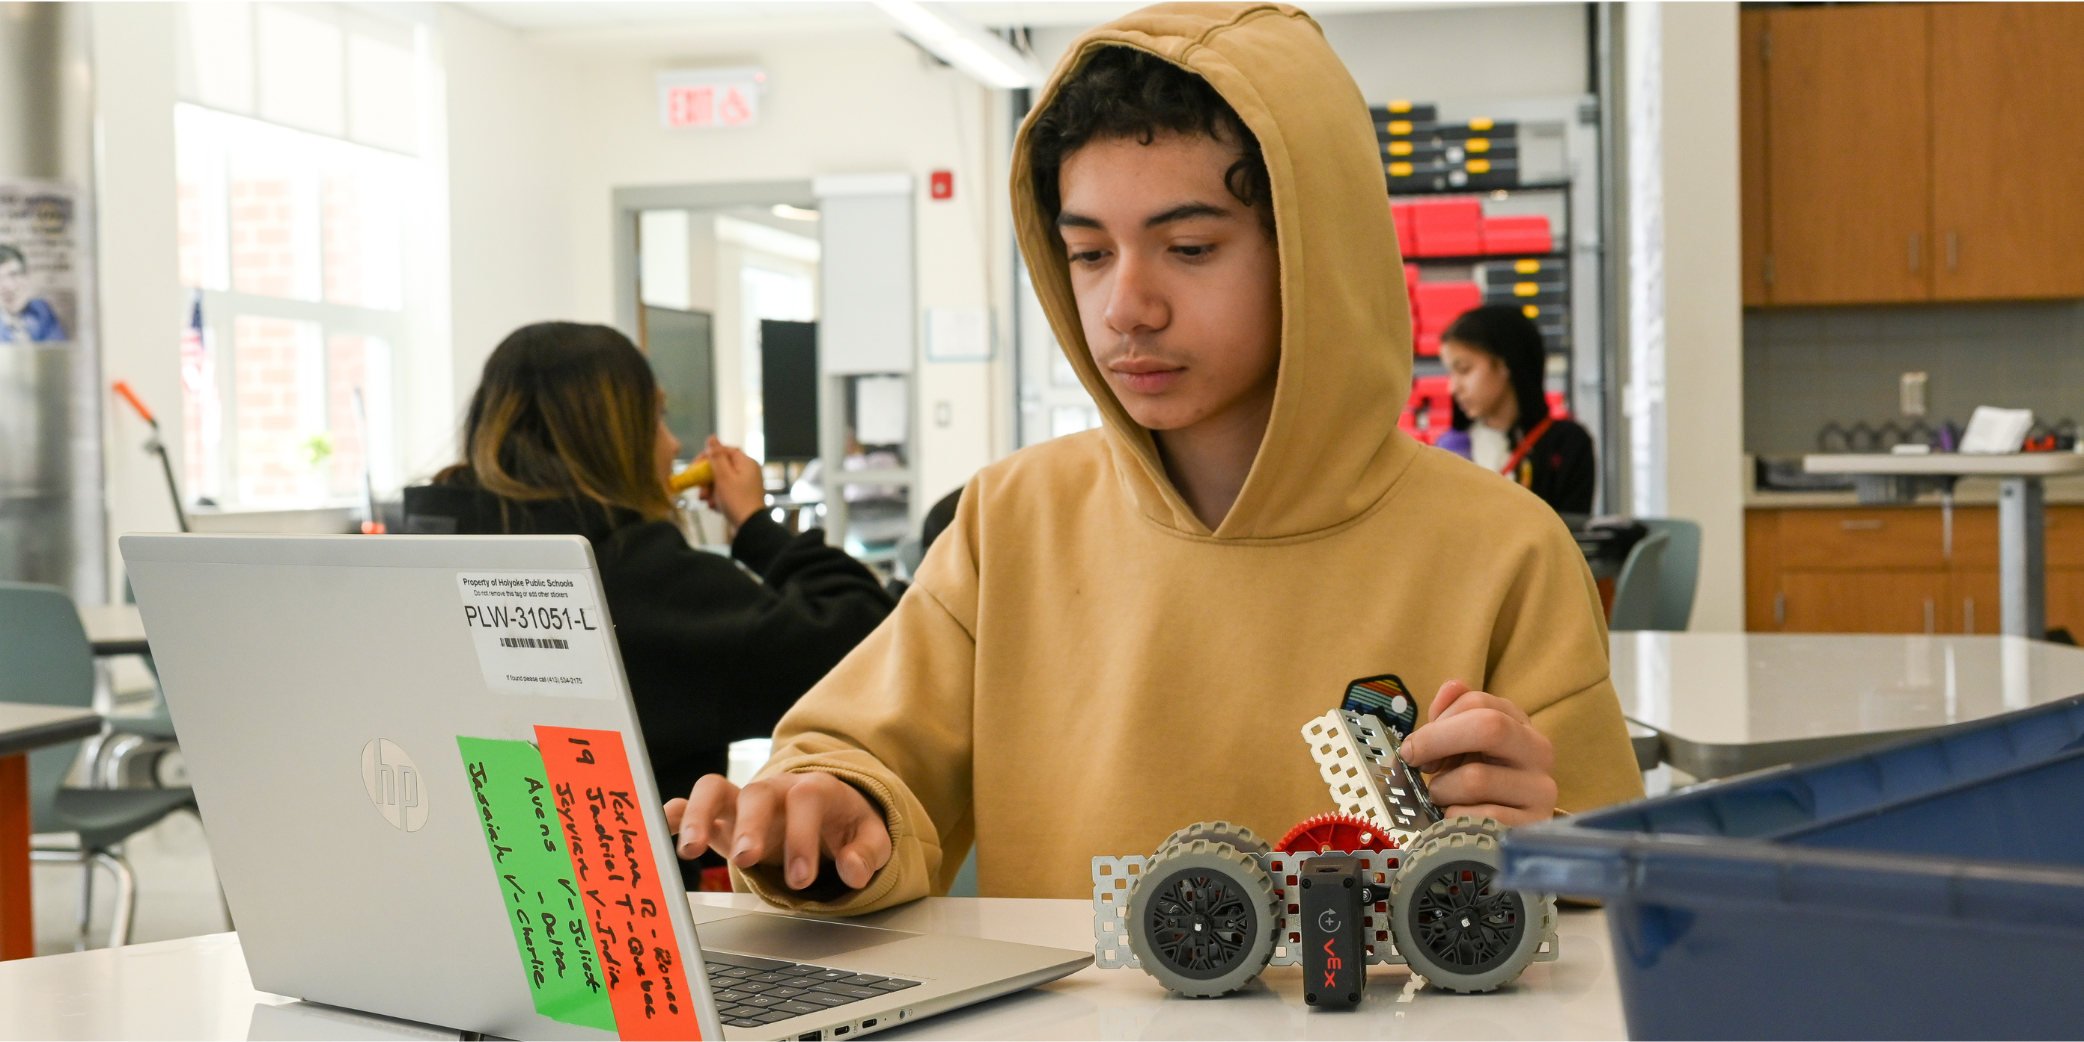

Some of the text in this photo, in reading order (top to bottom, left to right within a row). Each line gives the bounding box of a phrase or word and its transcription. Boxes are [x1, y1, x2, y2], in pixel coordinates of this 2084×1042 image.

[667, 86, 715, 126] EXIT
[463, 578, 489, 587] Property
[498, 579, 524, 588] Holyoke
[525, 579, 546, 587] Public
[547, 579, 574, 587] Schools
[464, 605, 597, 631] PLW-31051-L
[568, 737, 596, 765] 19
[370, 738, 420, 832] hp
[541, 912, 565, 979] Delta
[1324, 938, 1342, 988] VEX
[654, 946, 679, 1015] Romeo
